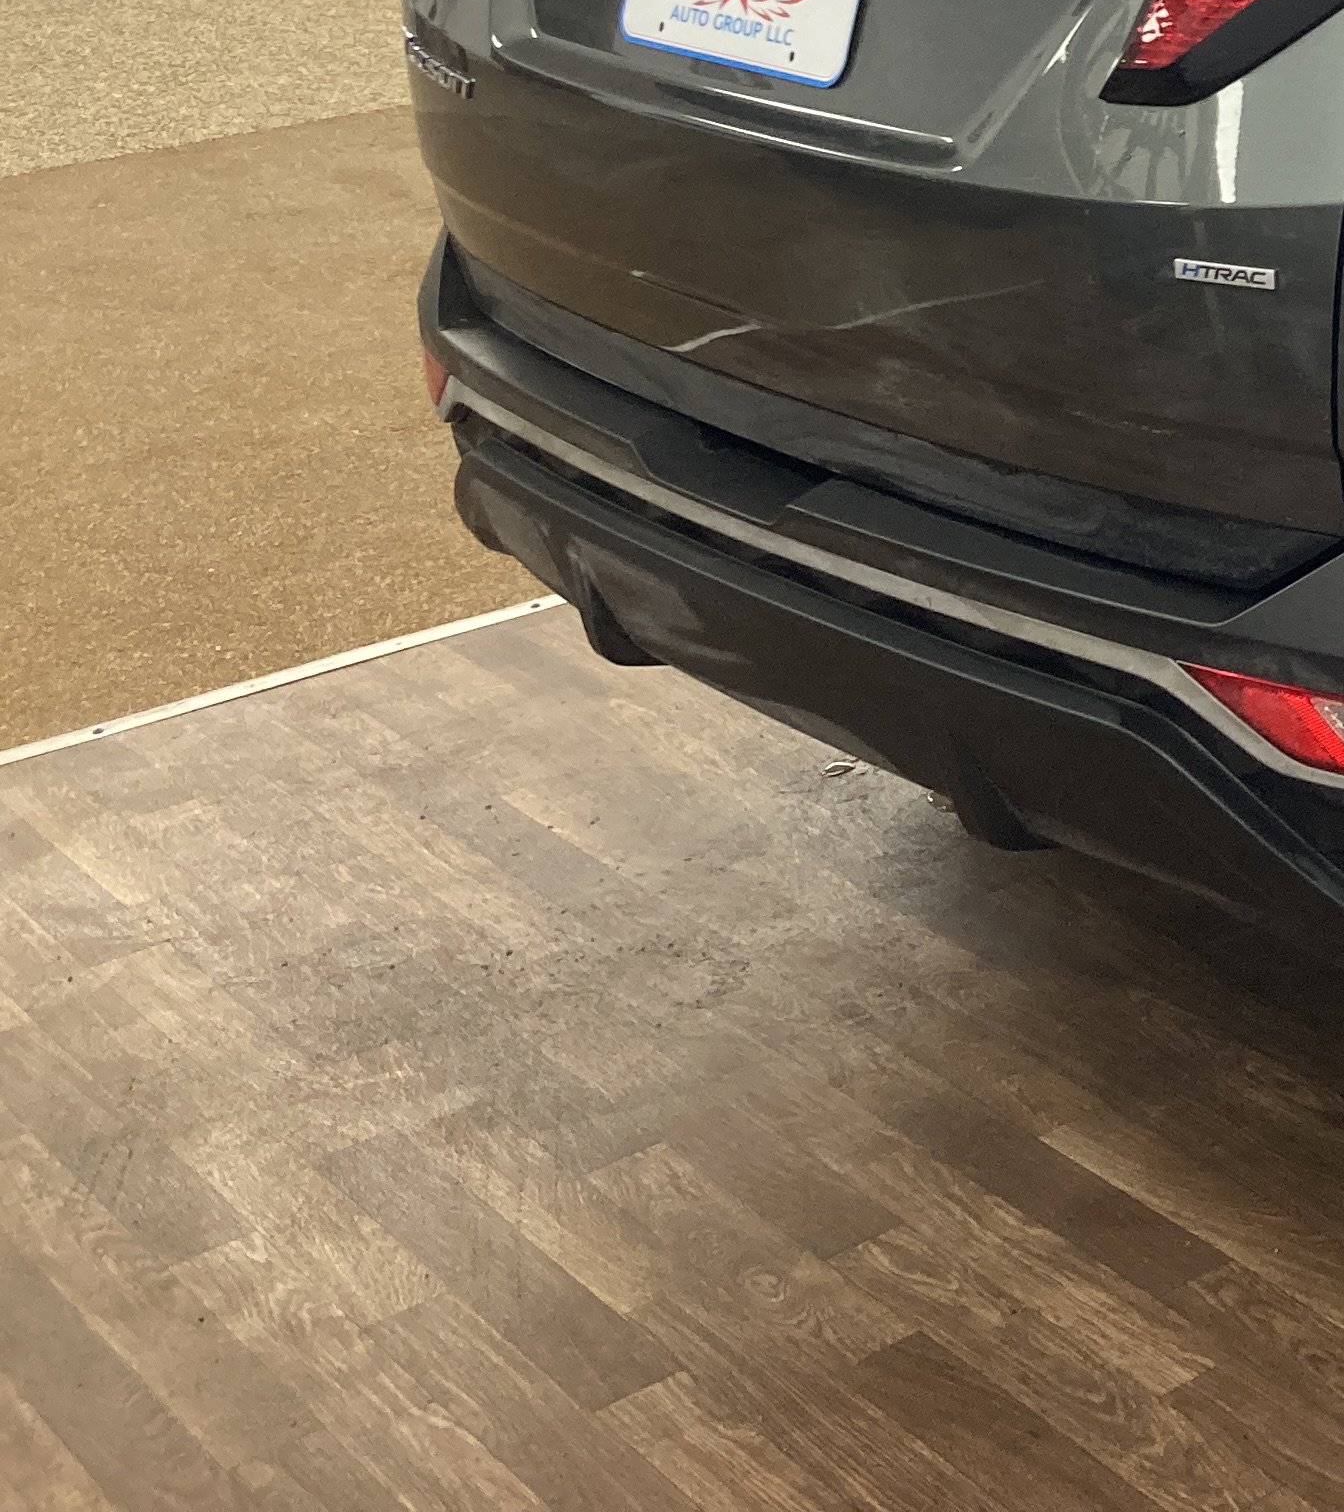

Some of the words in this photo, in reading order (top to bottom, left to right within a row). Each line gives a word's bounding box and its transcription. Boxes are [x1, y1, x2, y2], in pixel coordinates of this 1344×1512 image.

[670, 4, 710, 27] AUTO
[713, 12, 763, 39] GROUP
[765, 24, 795, 46] LLC
[1182, 262, 1266, 285] HTRAC
